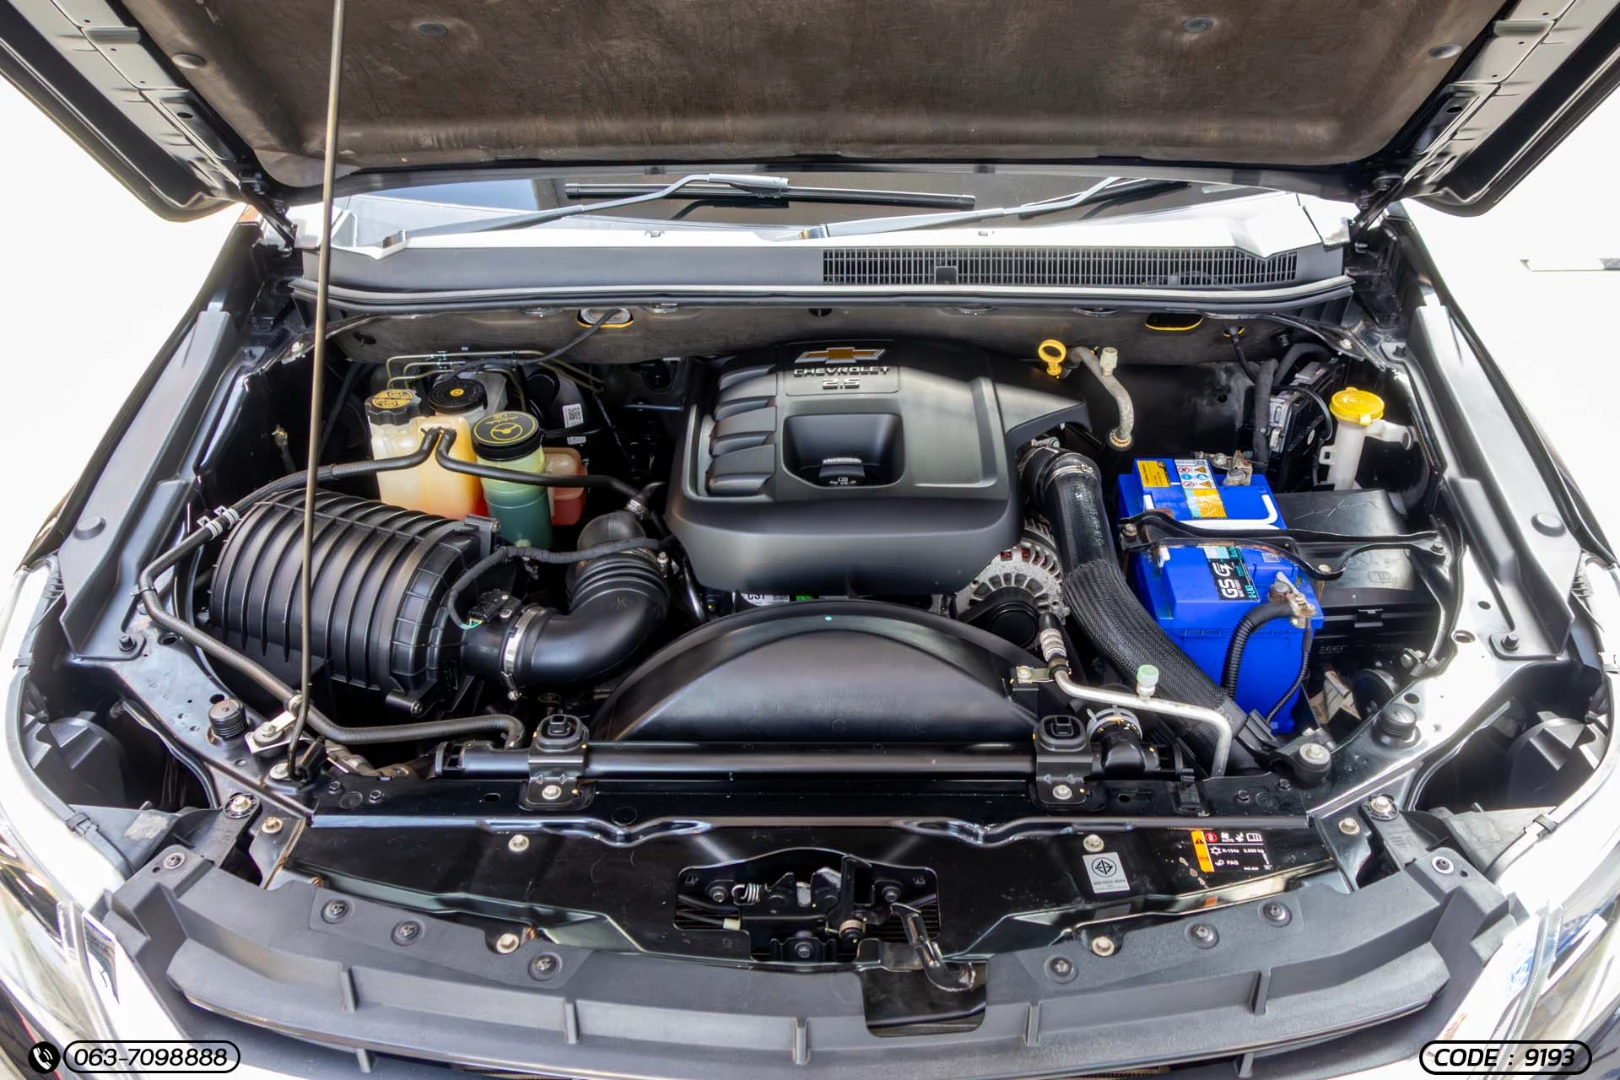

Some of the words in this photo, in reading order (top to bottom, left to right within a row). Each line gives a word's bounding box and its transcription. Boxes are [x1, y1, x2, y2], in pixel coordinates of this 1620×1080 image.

[794, 366, 890, 377] CHEVROLET
[822, 378, 860, 389] 2.5
[1218, 579, 1238, 599] GS
